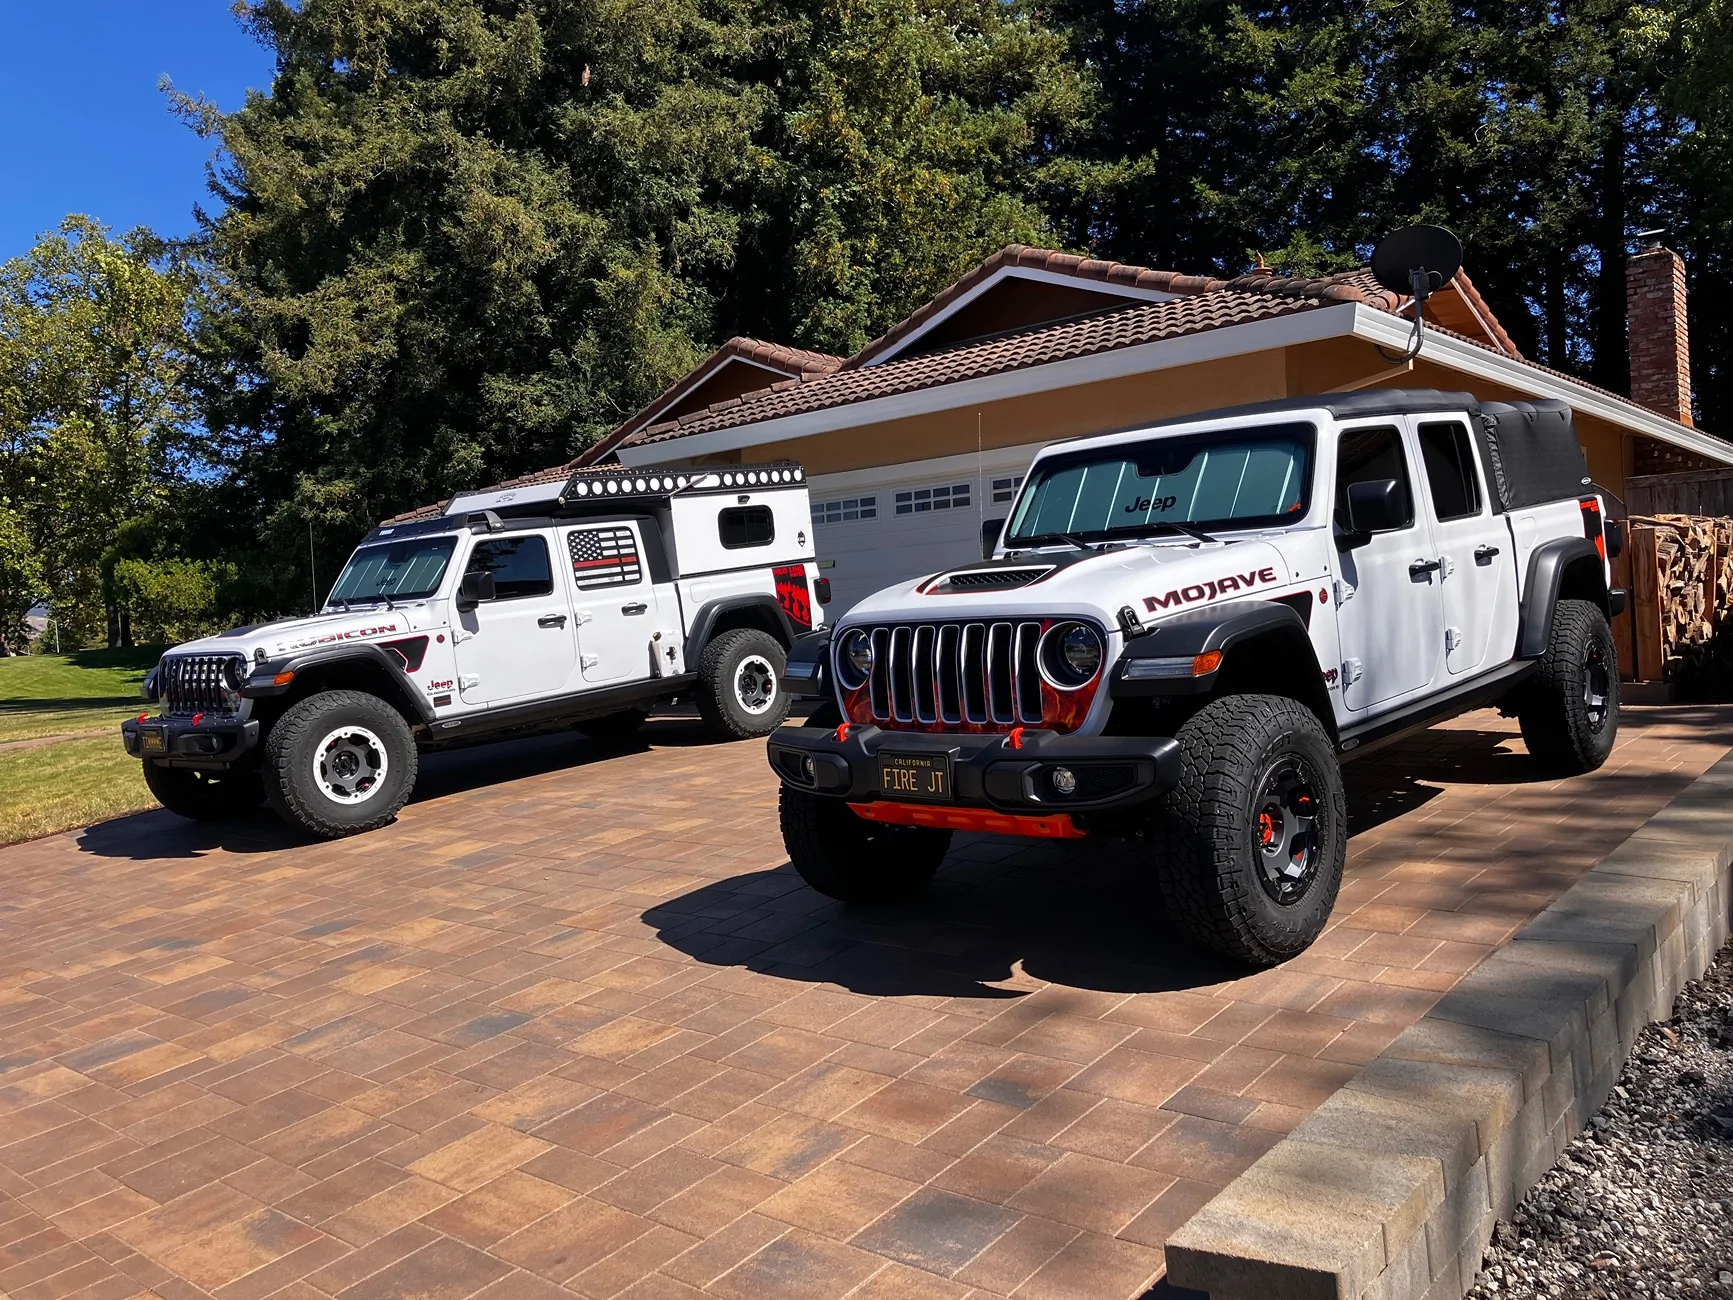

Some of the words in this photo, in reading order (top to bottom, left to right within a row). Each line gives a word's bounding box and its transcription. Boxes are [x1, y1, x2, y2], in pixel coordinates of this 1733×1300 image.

[1125, 495, 1177, 513] Jeep
[1142, 566, 1278, 613] MOJAVE
[427, 680, 454, 691] Jeep
[894, 758, 931, 767] CALIFORNIA
[883, 768, 918, 791] FIRE
[927, 771, 944, 793] JT
